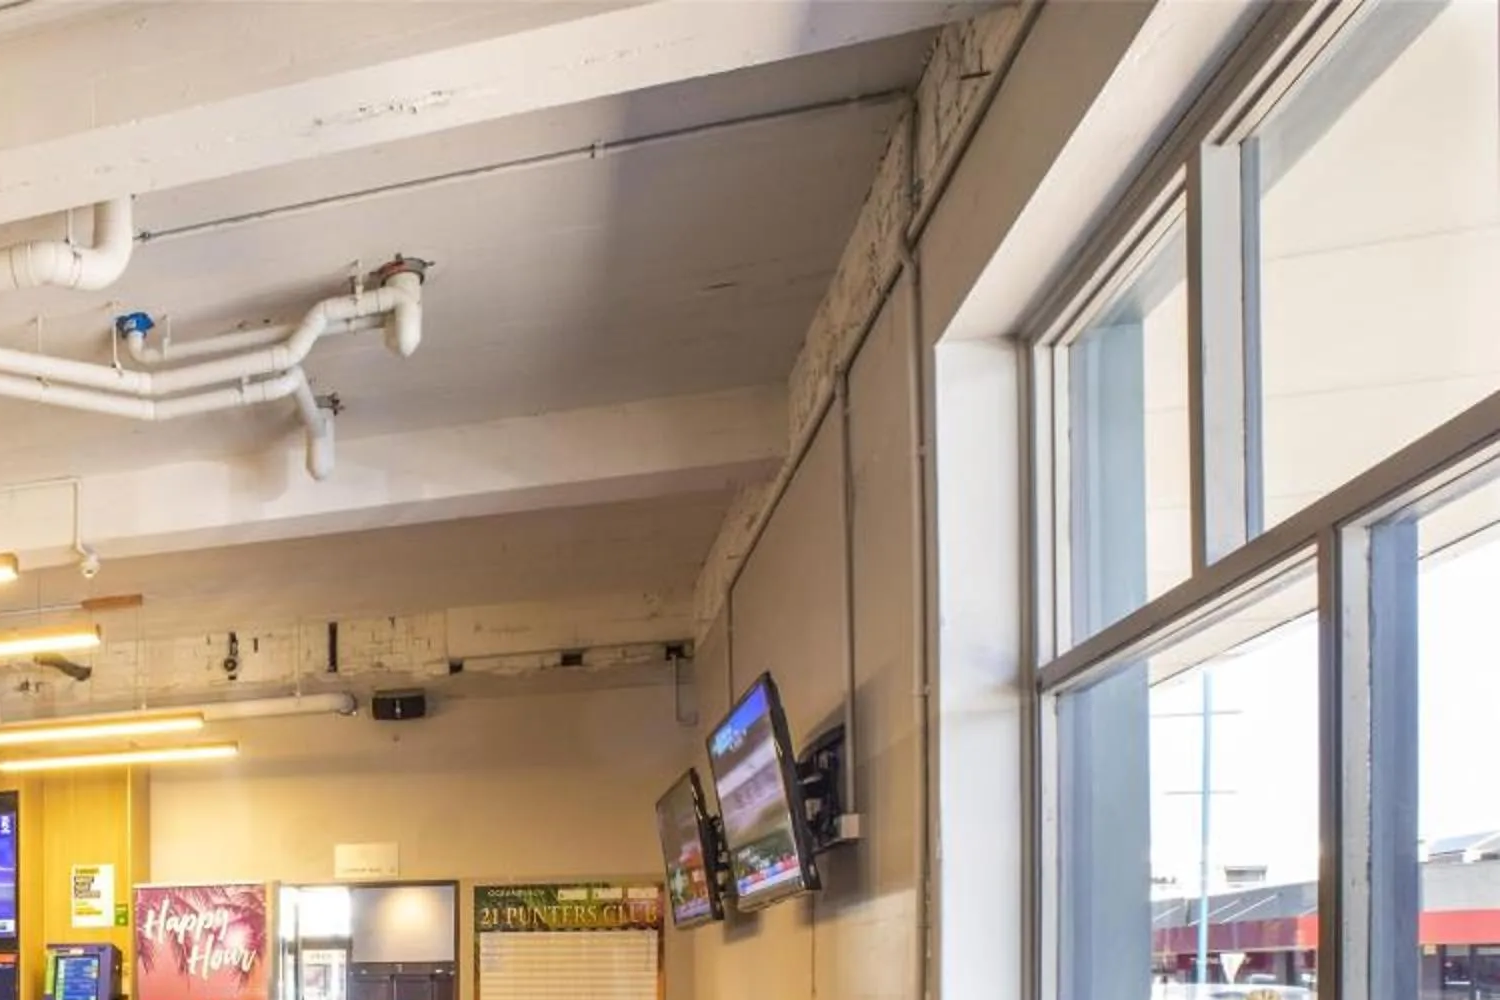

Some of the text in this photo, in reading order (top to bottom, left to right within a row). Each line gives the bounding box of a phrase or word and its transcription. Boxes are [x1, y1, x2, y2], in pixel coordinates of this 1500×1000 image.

[143, 898, 228, 944] Happy
[480, 900, 657, 926] 21 PUNTERS CLUB
[188, 932, 257, 980] Hour
